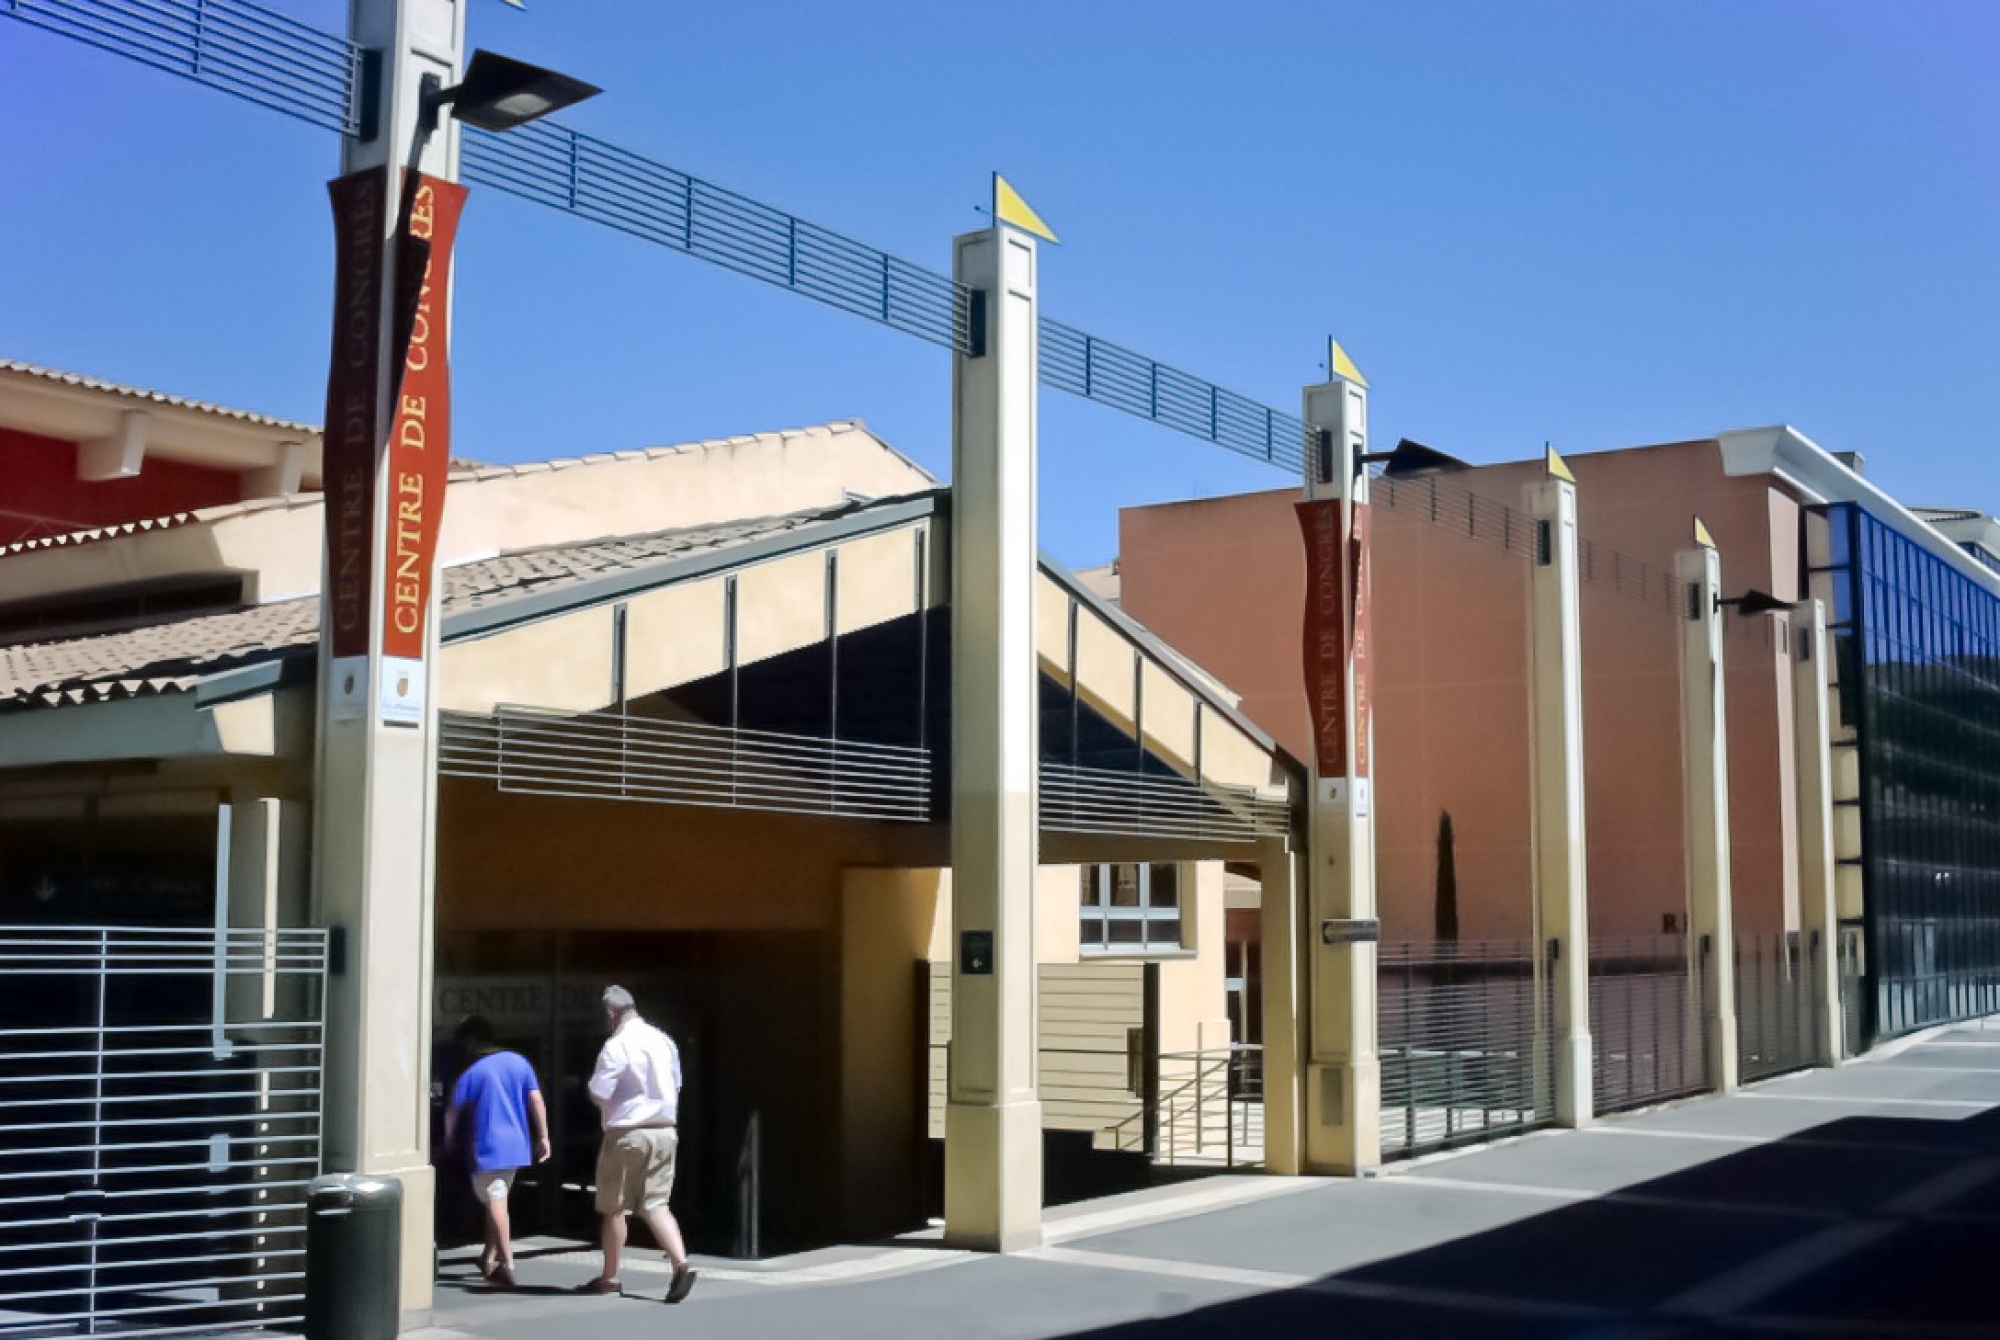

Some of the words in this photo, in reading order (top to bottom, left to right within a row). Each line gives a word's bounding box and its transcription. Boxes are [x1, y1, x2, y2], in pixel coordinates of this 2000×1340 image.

[344, 391, 366, 443] DE
[400, 395, 427, 449] DE
[336, 471, 364, 631] CENTRE
[395, 472, 424, 635] CENTRE
[1321, 672, 1338, 764] CENTRE
[439, 985, 544, 1011] CENTRE
